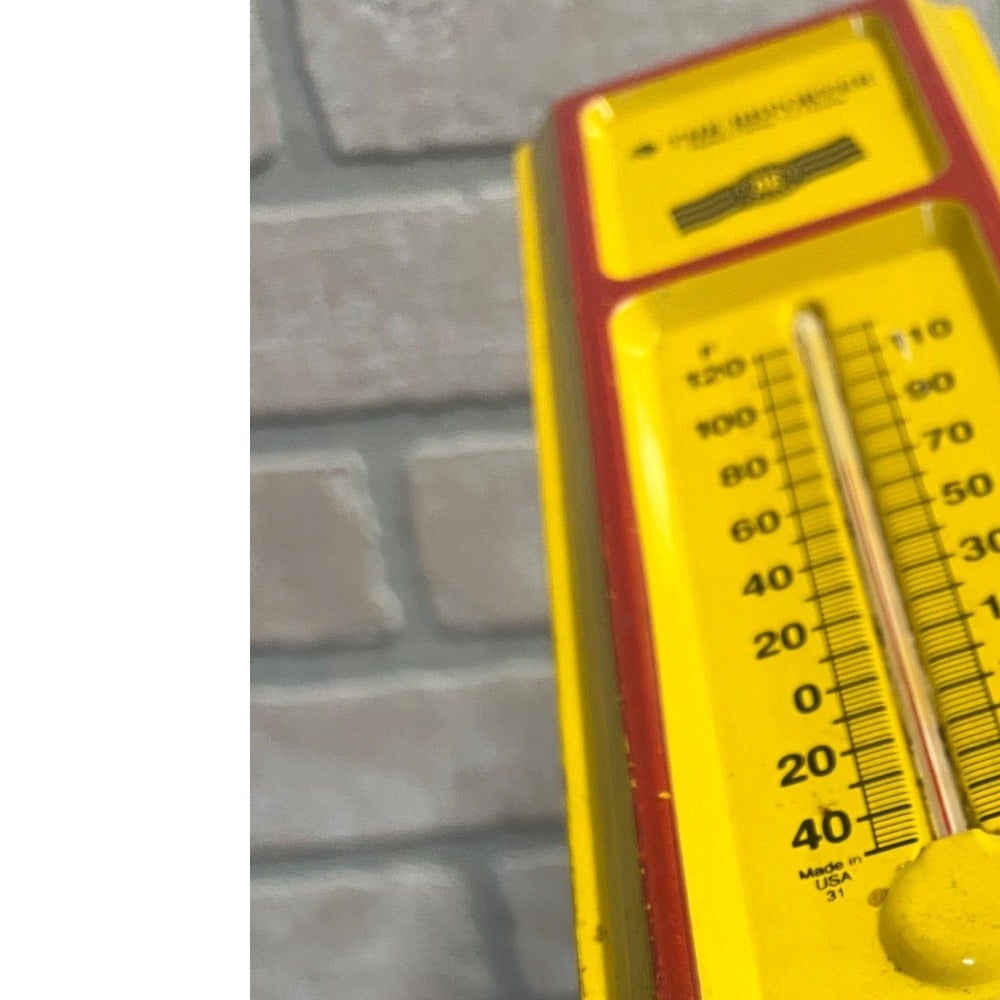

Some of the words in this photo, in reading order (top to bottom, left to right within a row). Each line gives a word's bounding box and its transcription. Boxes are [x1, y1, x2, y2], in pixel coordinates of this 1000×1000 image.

[687, 357, 746, 389] 120
[905, 371, 956, 402] 90
[695, 405, 757, 439] 100
[922, 420, 974, 452] 70
[720, 455, 769, 488] 80
[941, 473, 994, 506] 50
[730, 509, 781, 543] 60
[743, 564, 794, 597] 40
[754, 622, 808, 660] 20
[793, 683, 822, 714] 0
[777, 744, 837, 788] 20
[792, 809, 852, 850] 40
[799, 861, 843, 880] Made
[848, 855, 863, 866] in
[815, 871, 853, 891] USA
[826, 887, 845, 902] 31
